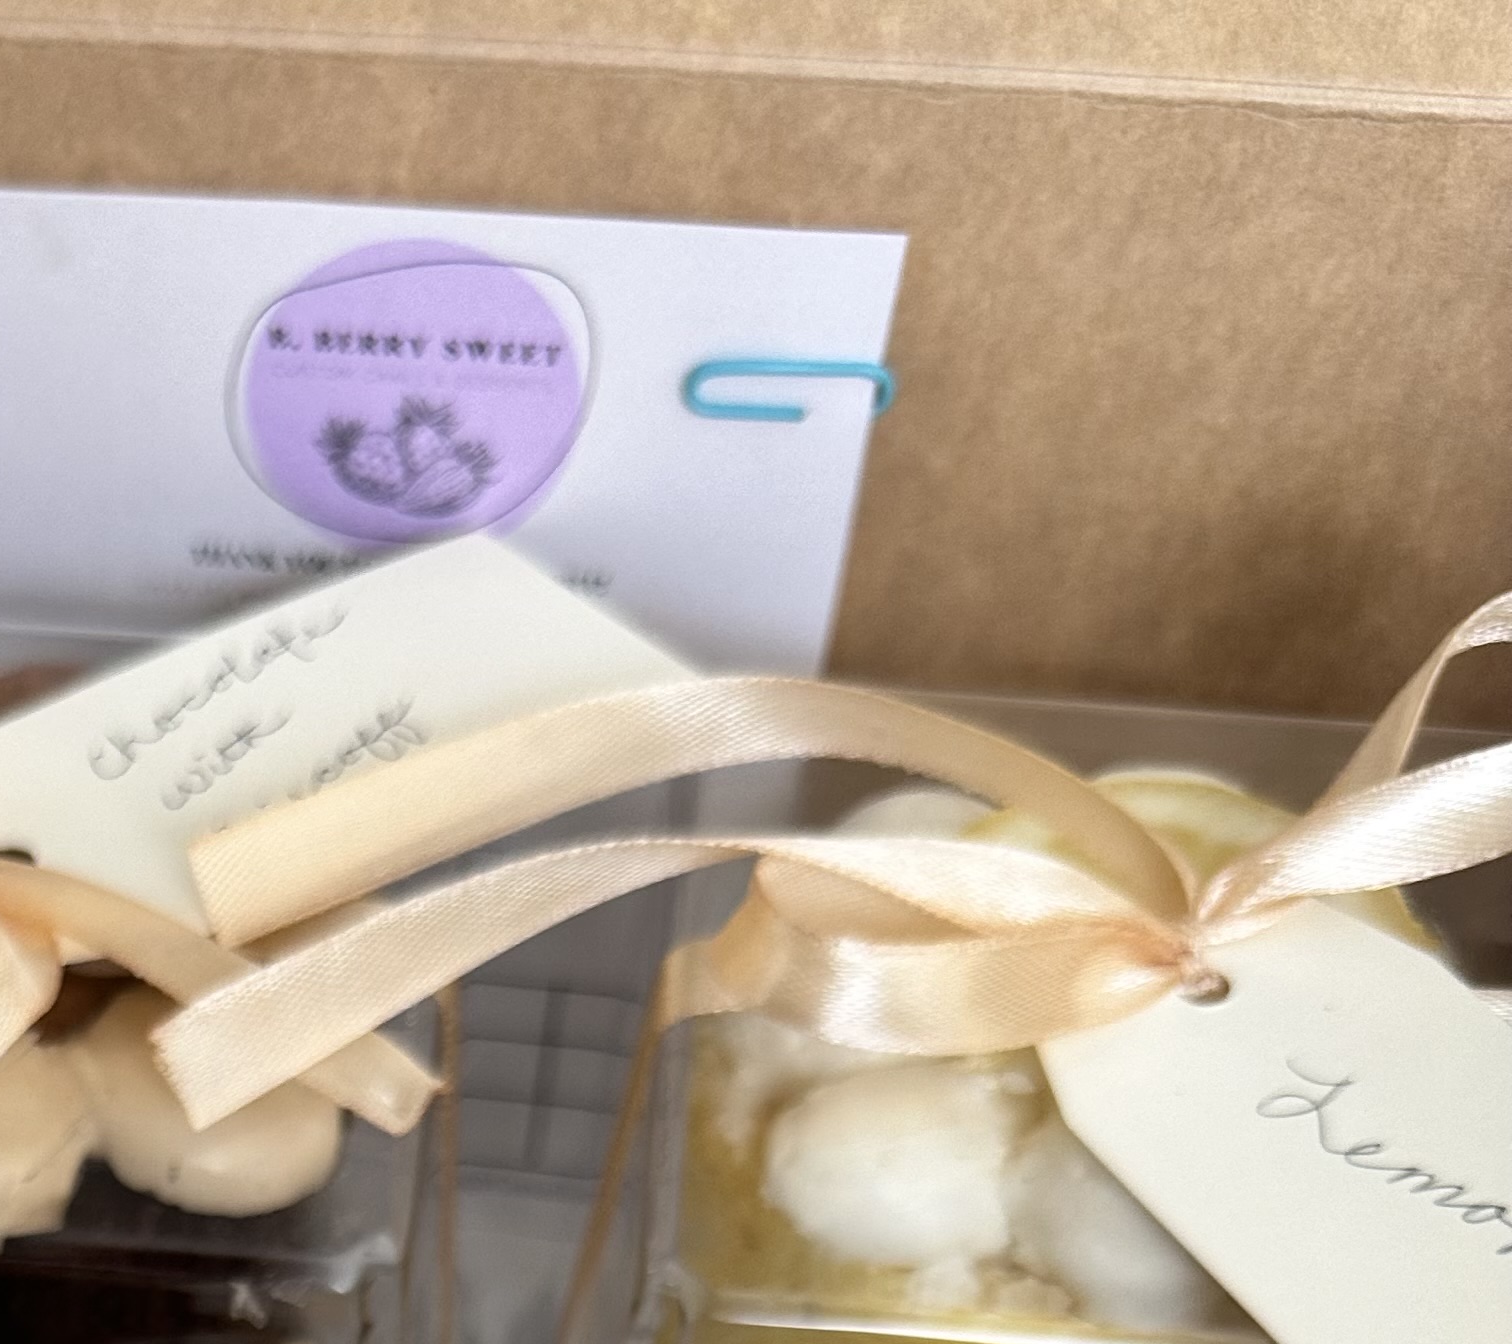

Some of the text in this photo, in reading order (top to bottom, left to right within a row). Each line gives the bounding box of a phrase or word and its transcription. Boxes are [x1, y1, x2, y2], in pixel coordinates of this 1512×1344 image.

[314, 330, 432, 360] BERRY
[443, 337, 562, 368] SWEET
[1255, 1056, 1512, 1256] Lemo
